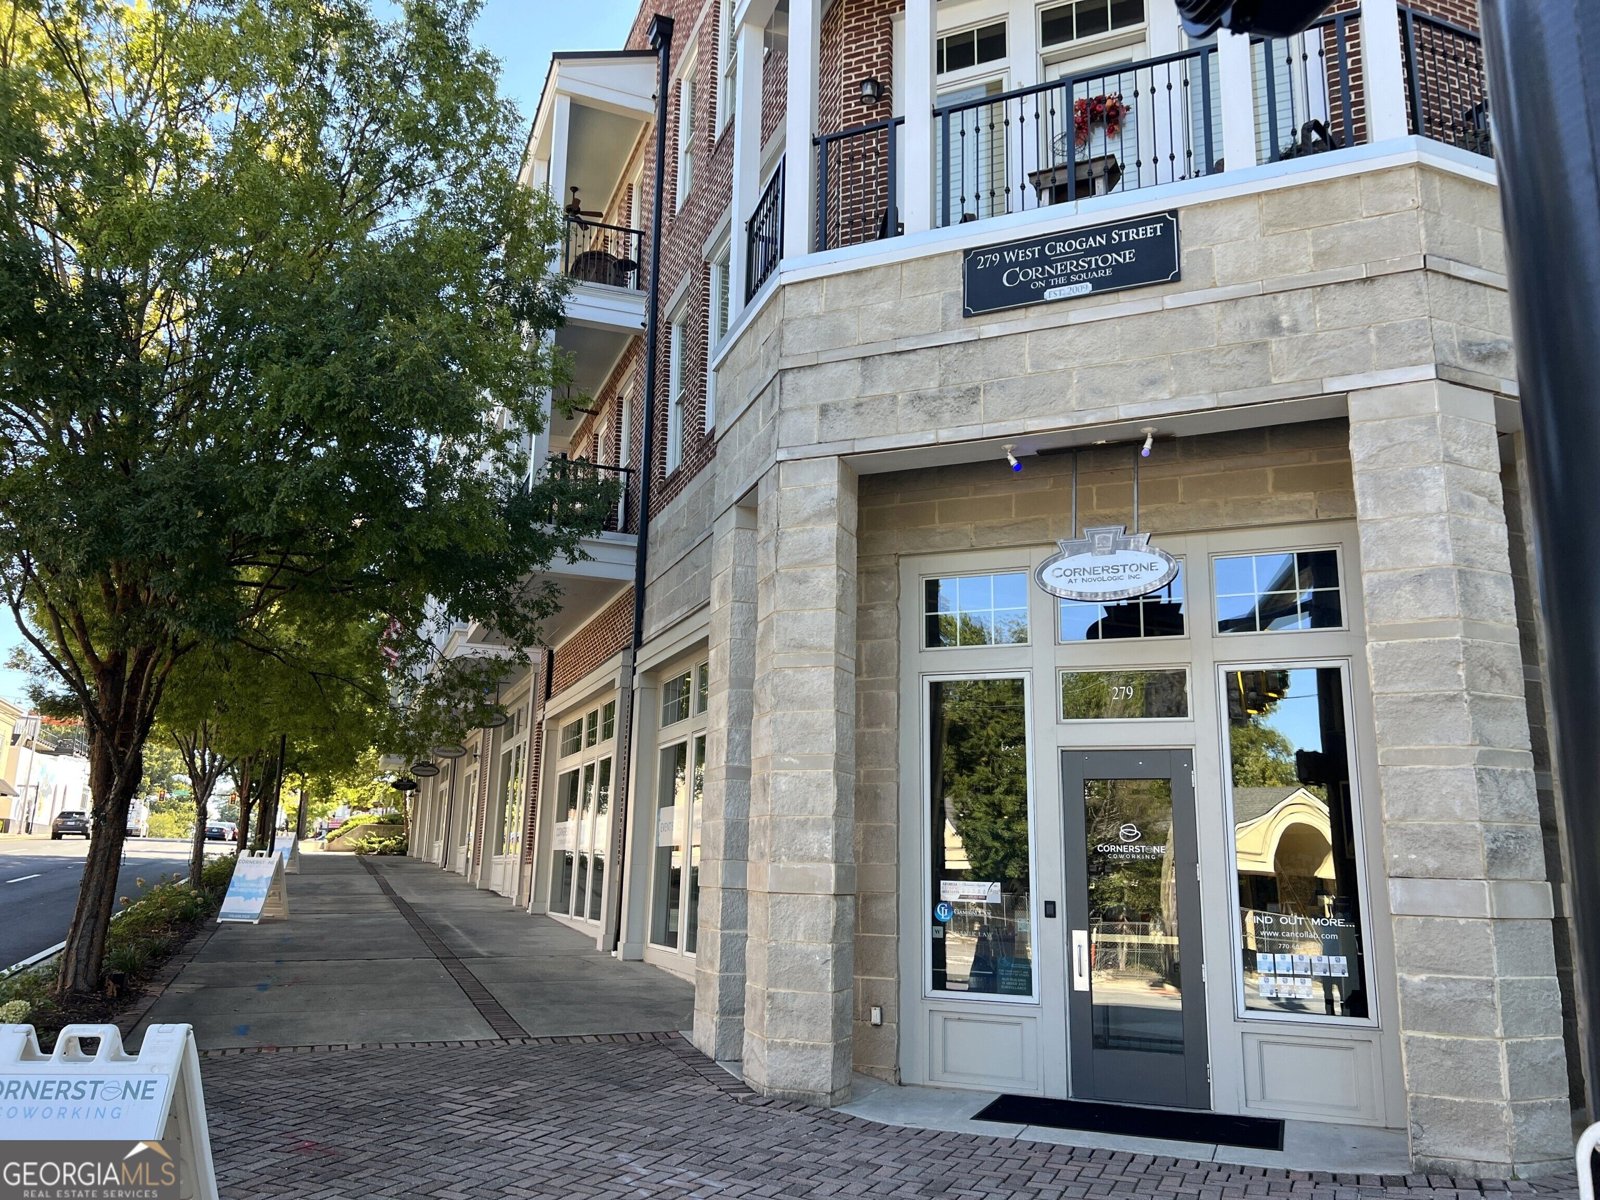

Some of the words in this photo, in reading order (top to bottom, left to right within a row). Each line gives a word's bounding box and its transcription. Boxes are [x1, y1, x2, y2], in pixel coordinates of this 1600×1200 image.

[976, 252, 1000, 270] 279
[1004, 246, 1042, 264] WEST
[1045, 233, 1107, 255] CROGAN
[1112, 223, 1164, 243] STREET
[1002, 249, 1136, 287] CORNERSTONE
[1030, 279, 1046, 290] ON
[1049, 276, 1068, 286] THE
[1070, 268, 1113, 282] SQUARE
[1052, 562, 1159, 579] CORNERSTONE
[1112, 686, 1134, 700] 279
[1097, 845, 1166, 854] CORNERSTONE
[1246, 915, 1273, 925] IND
[1280, 915, 1305, 926] OUT
[0, 1080, 157, 1101] RNERSTONE
[0, 1106, 123, 1120] OWORKING
